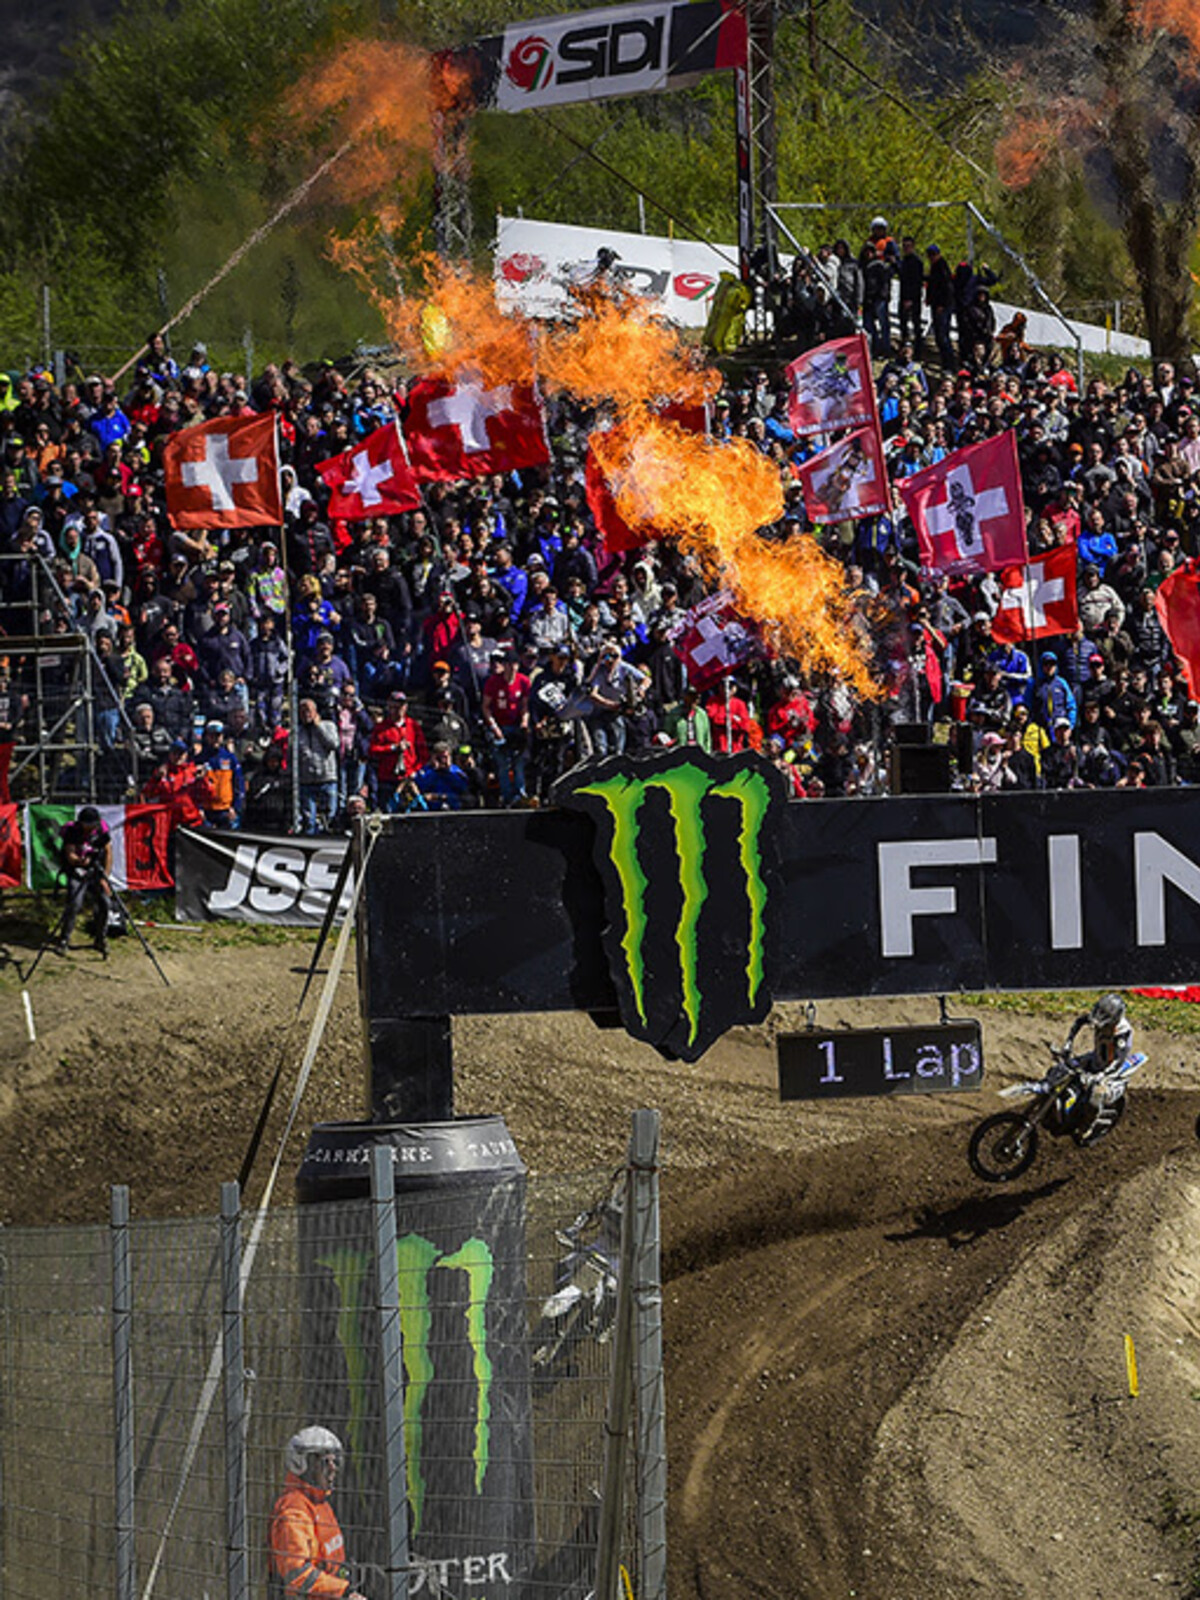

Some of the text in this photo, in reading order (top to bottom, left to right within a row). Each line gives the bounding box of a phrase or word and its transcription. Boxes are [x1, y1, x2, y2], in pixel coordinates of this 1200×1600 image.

[556, 16, 665, 85] SIDI
[817, 1037, 980, 1087] 1 Lap
